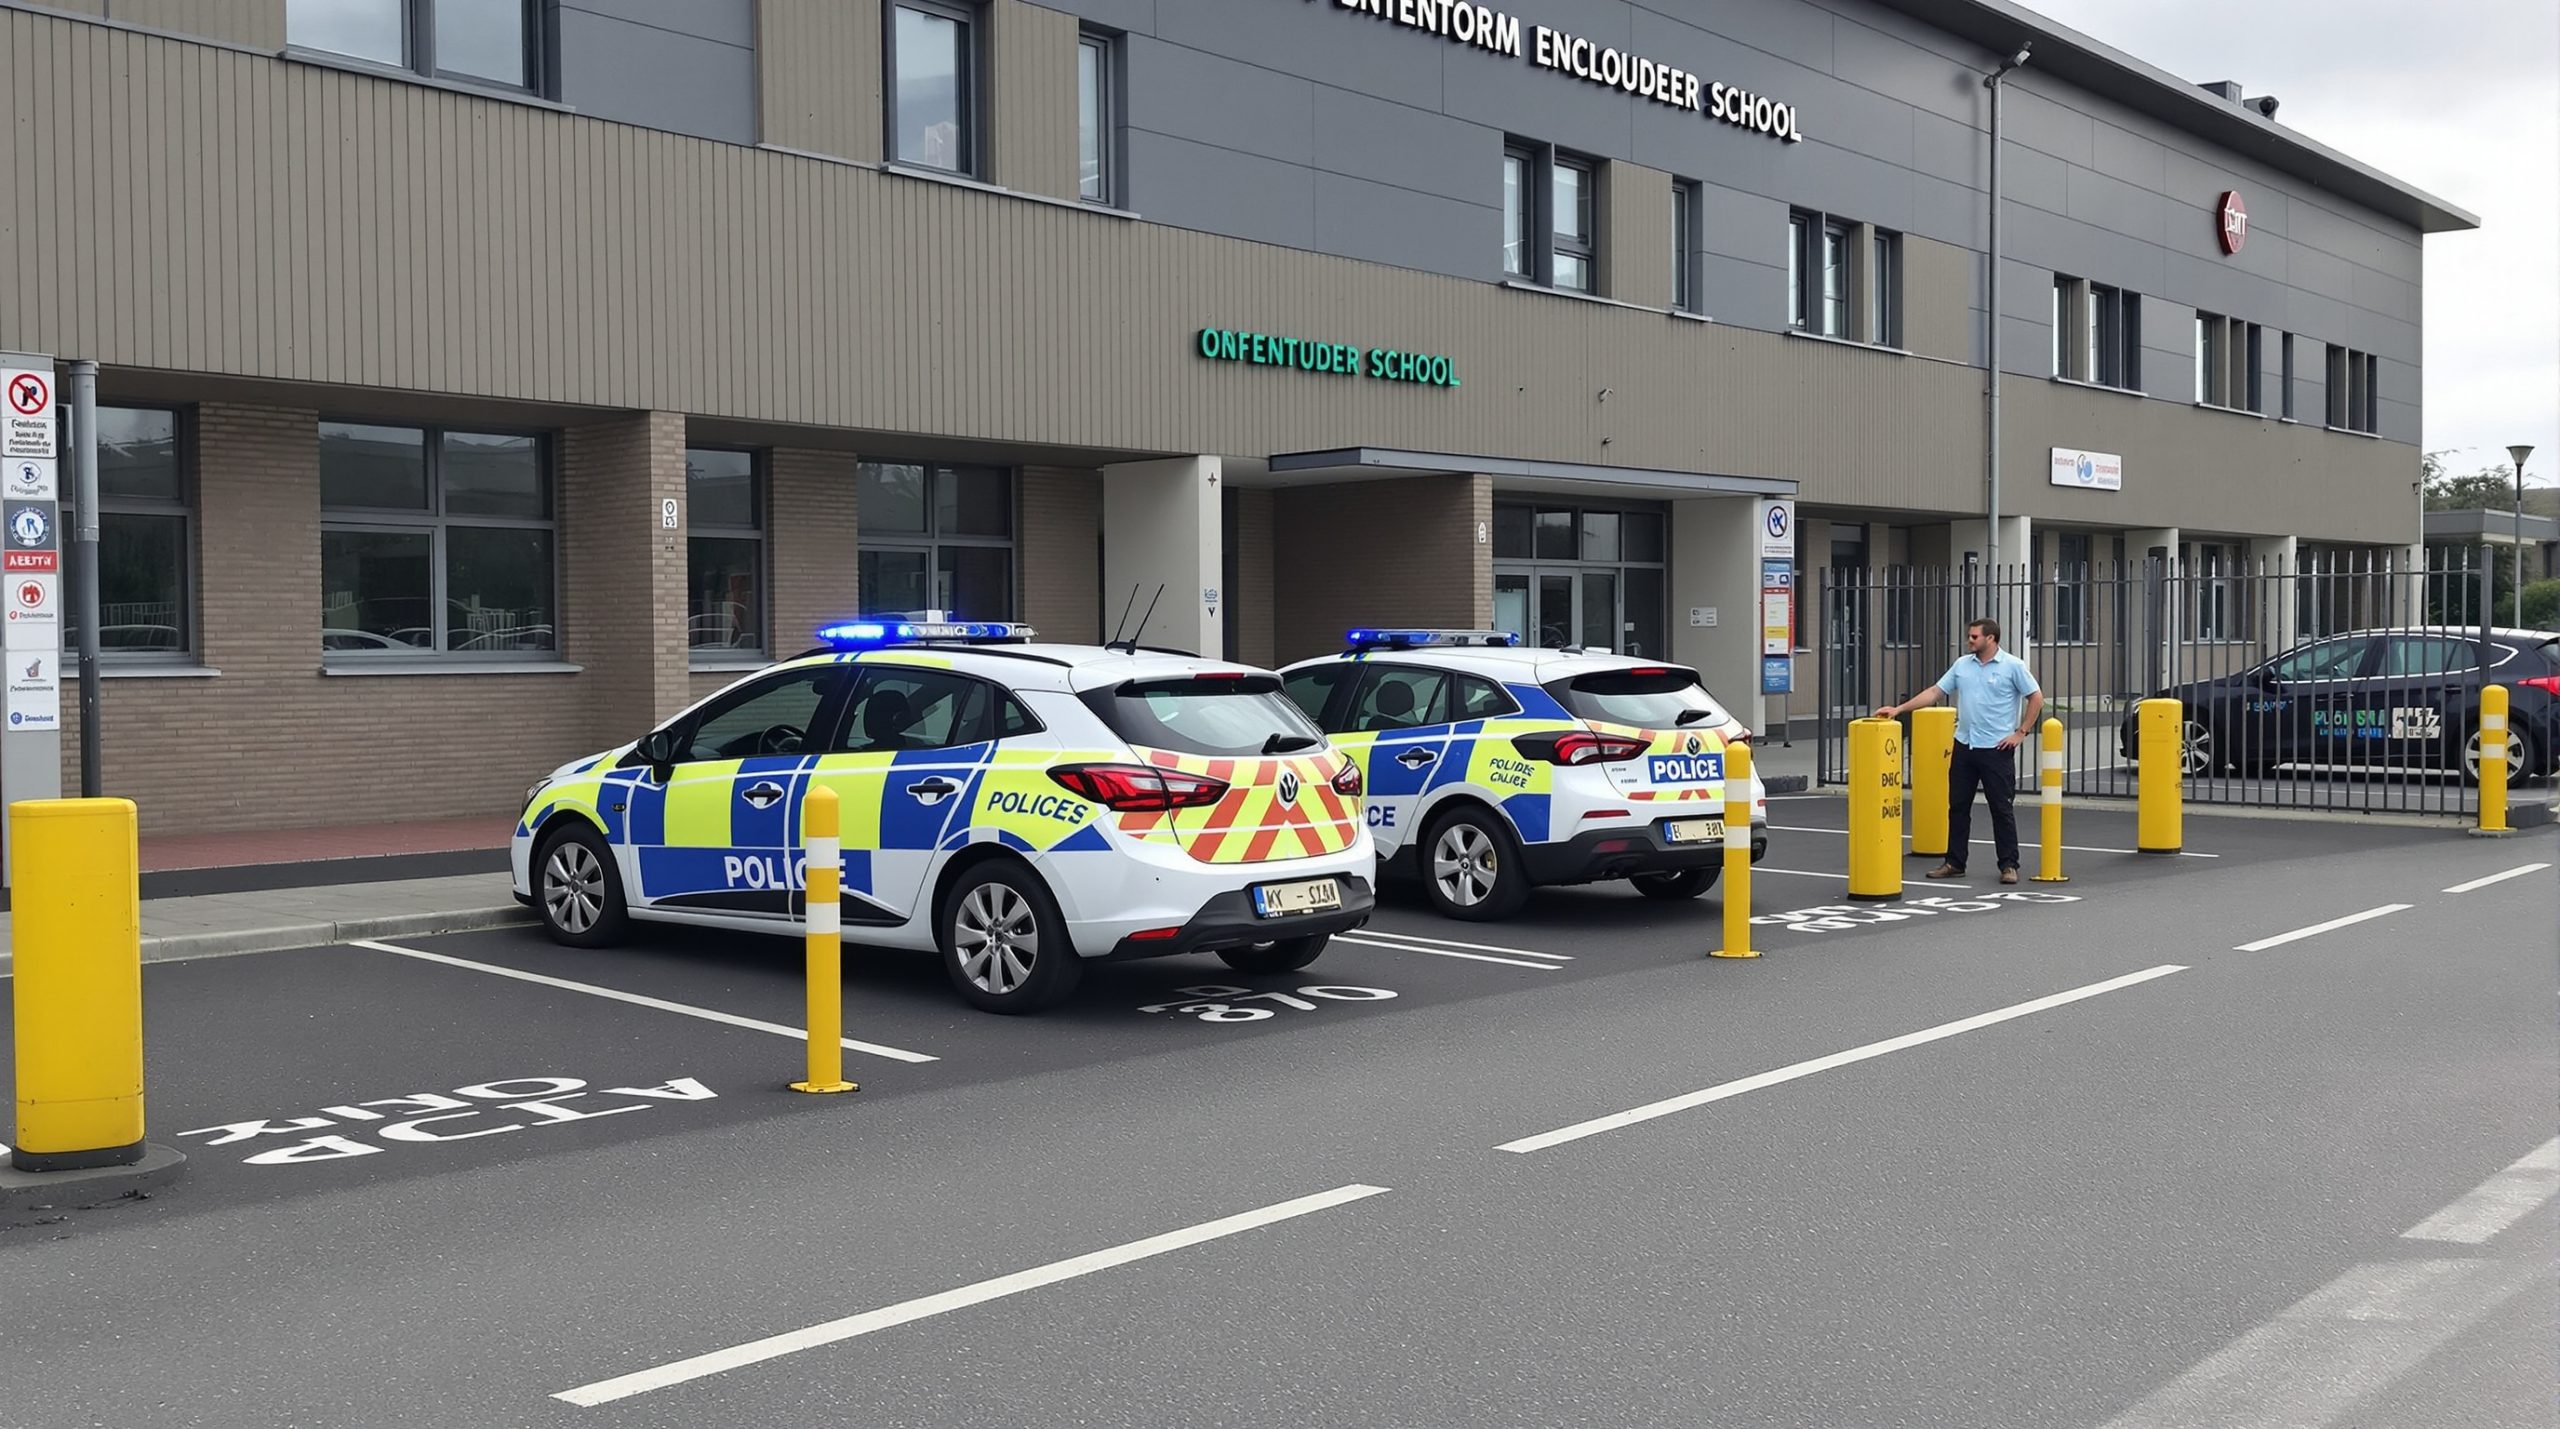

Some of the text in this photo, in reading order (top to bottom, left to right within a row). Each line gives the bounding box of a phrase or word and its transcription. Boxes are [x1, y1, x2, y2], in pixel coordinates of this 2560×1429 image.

[1341, 0, 1802, 142] ENTORM ENCLOUDEER SCHOOL
[1370, 348, 1462, 386] SCHOOL
[1653, 759, 1720, 781] POLICE
[987, 790, 1089, 825] POLICES
[1366, 804, 1396, 827] CE
